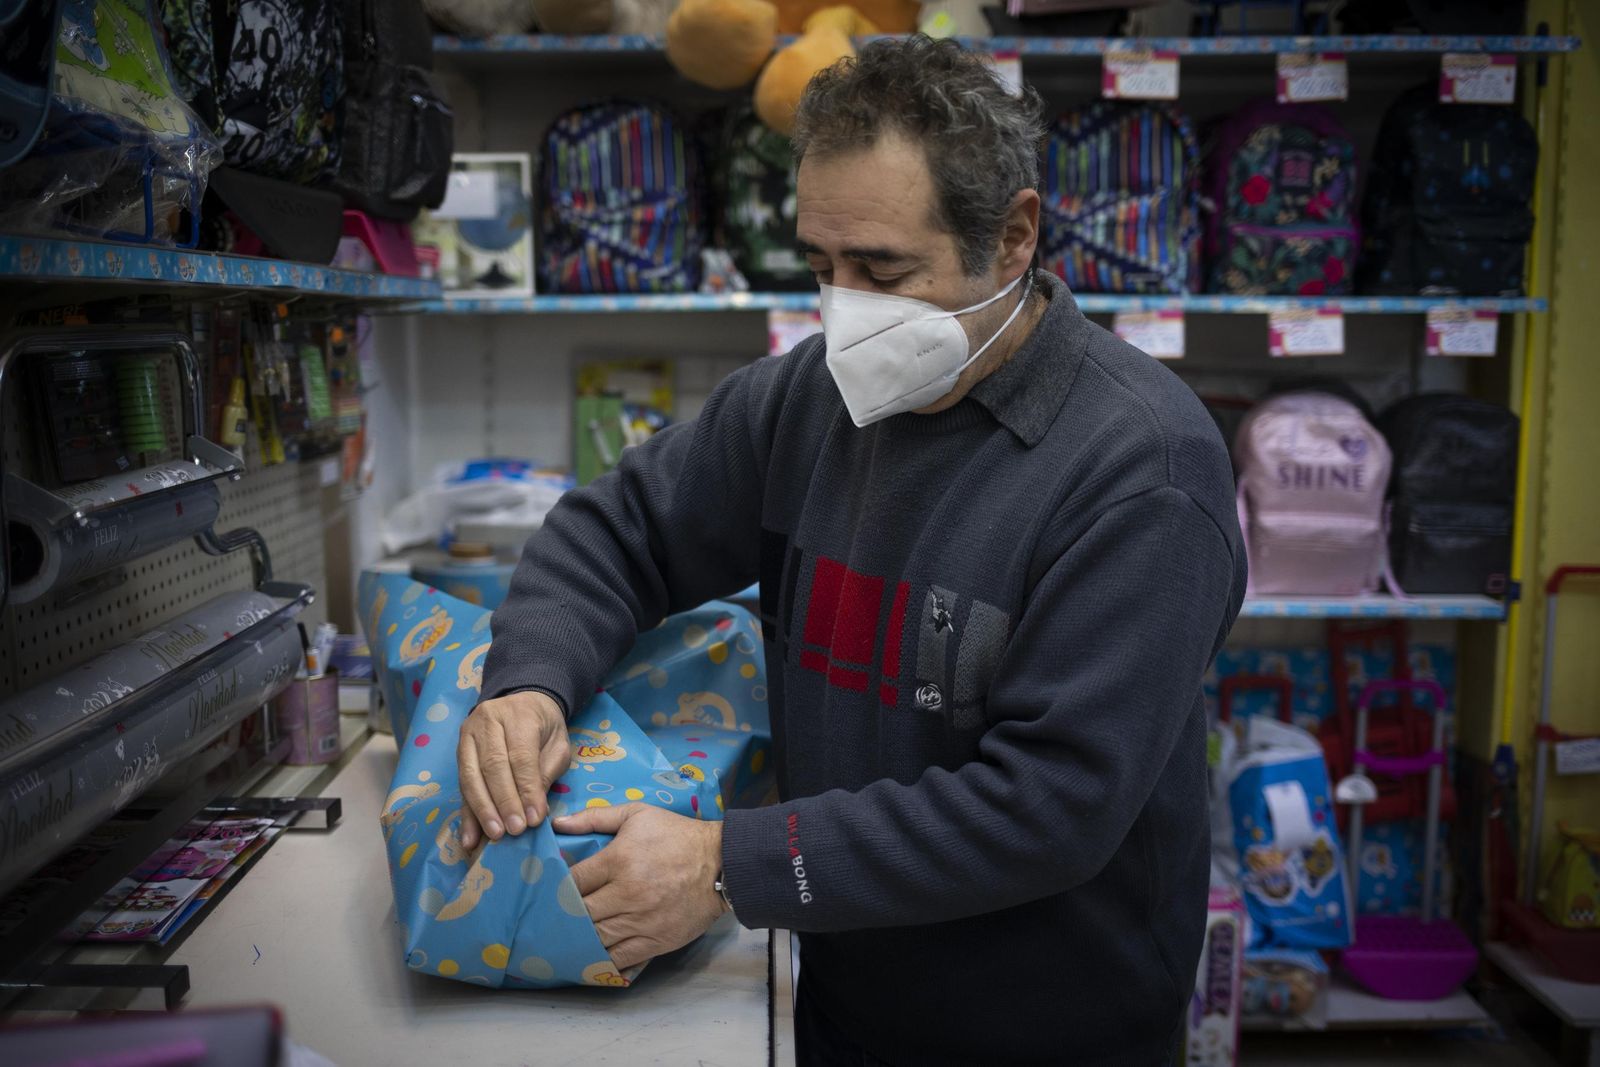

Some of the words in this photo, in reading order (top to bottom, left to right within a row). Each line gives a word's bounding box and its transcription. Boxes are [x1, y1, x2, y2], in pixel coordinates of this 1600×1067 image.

[232, 28, 282, 65] 40
[1277, 462, 1366, 491] SHINE
[94, 525, 118, 547] FELIZ
